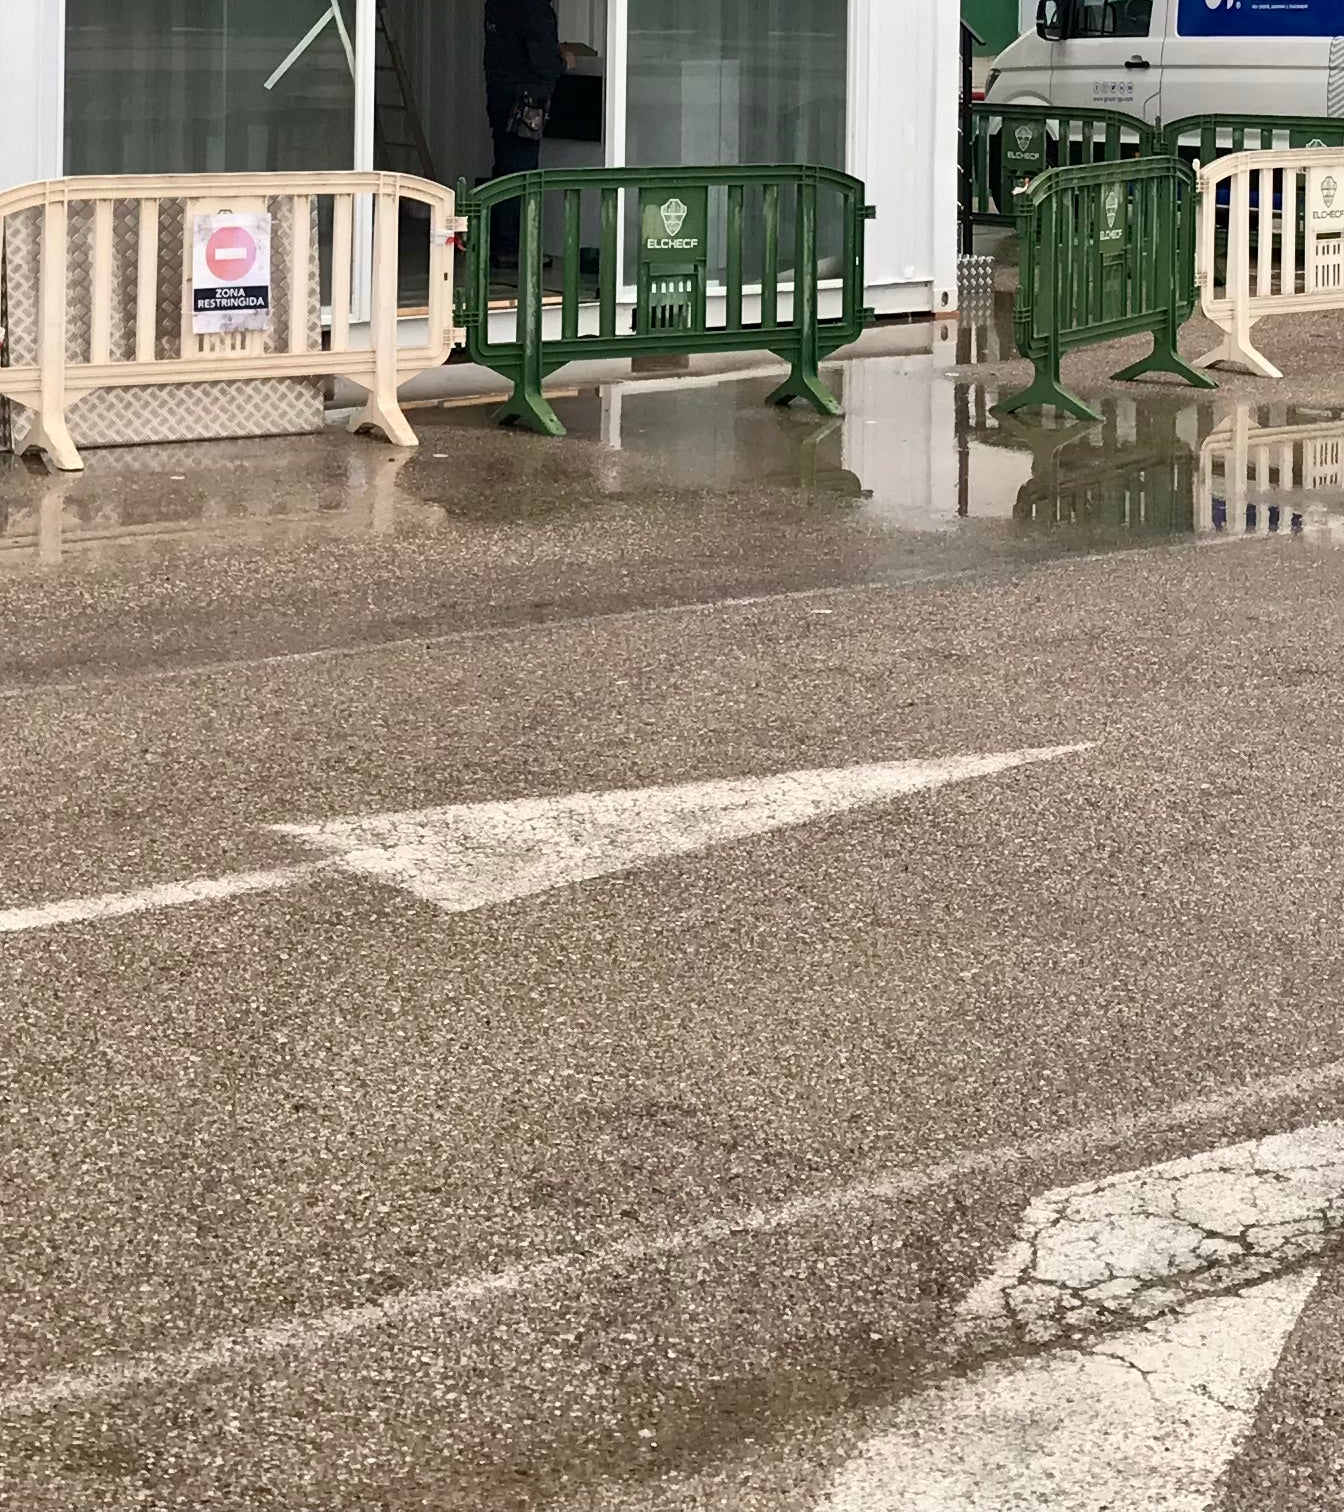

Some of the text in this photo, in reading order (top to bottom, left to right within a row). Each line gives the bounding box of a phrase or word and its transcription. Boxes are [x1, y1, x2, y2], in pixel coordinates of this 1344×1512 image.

[647, 238, 698, 249] ELCHECF
[215, 288, 246, 298] ZONA
[197, 297, 265, 308] RESTRINGIDA
